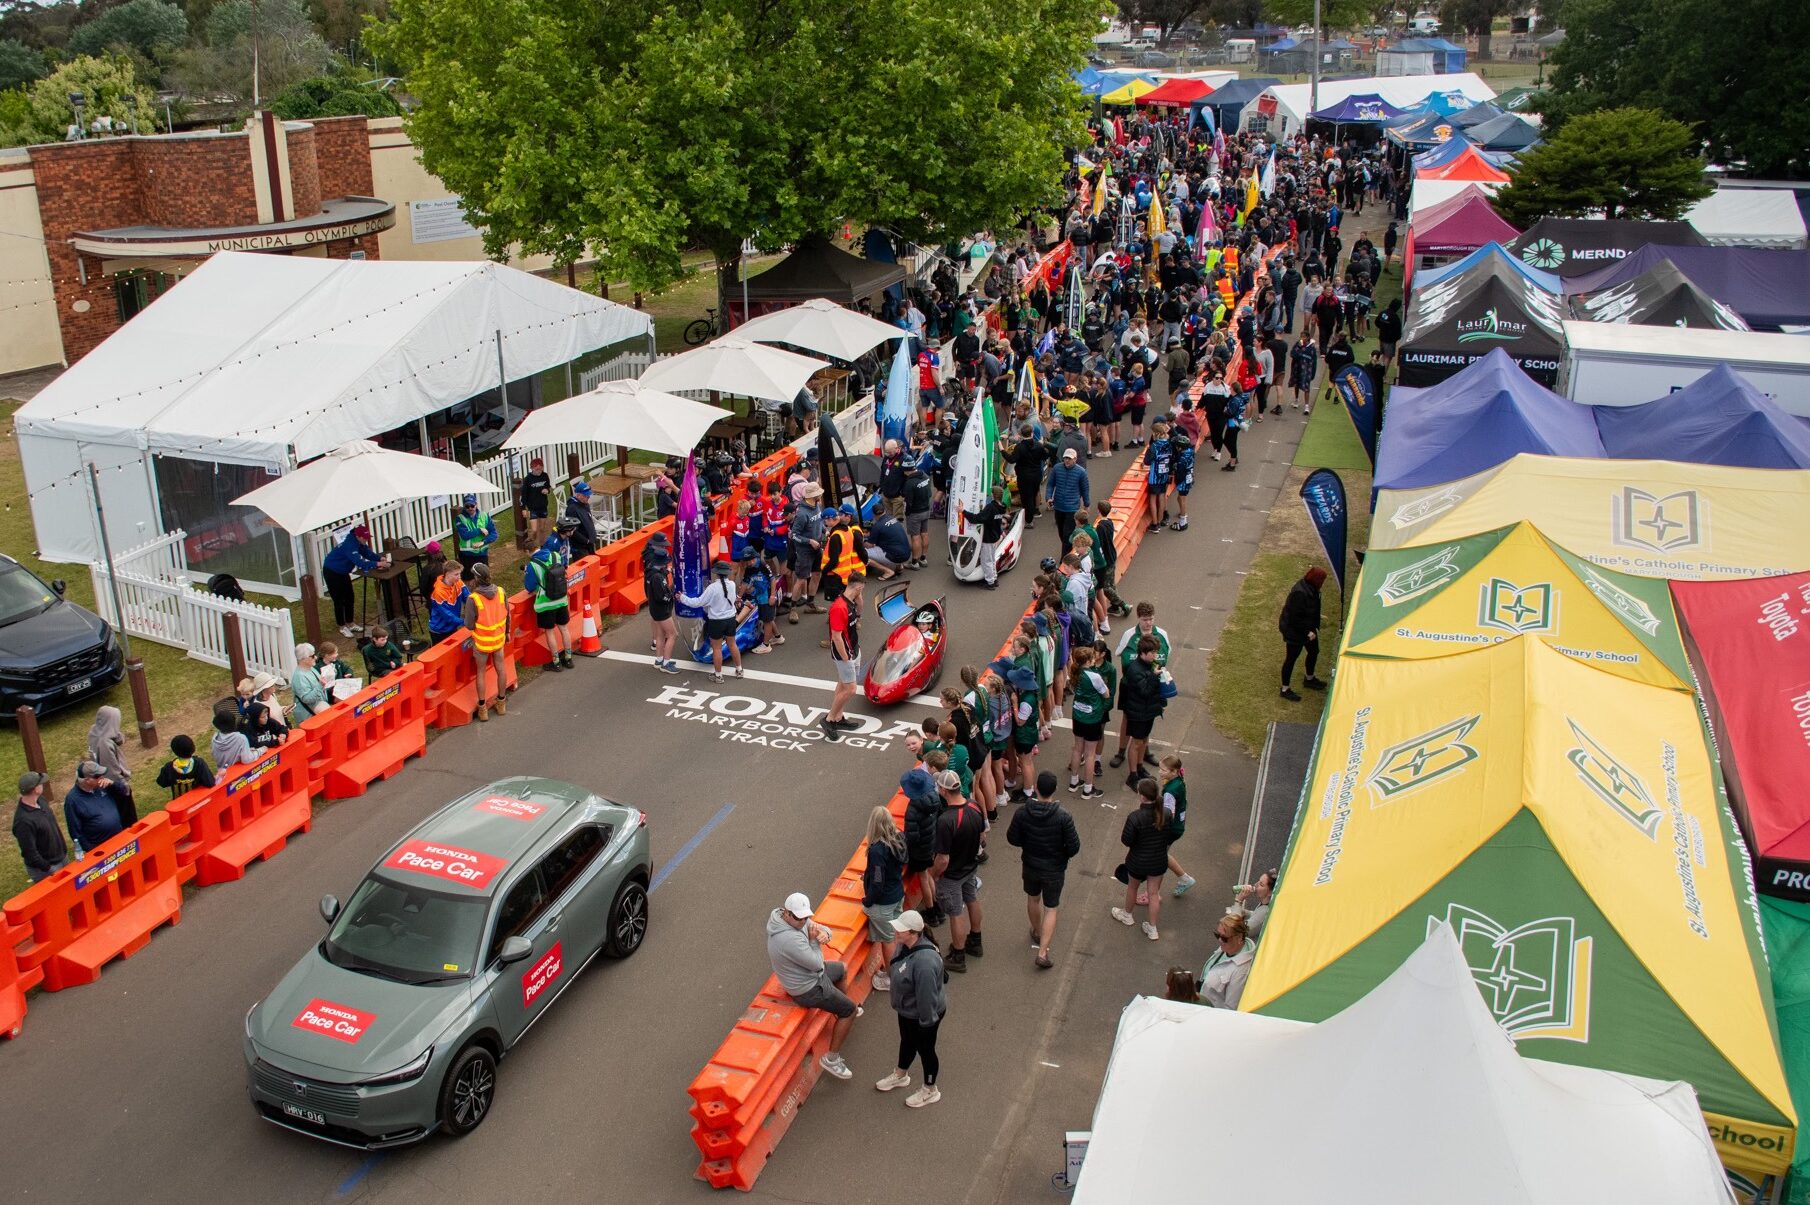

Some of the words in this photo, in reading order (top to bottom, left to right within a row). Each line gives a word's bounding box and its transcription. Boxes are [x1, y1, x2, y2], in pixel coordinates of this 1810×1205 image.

[208, 234, 292, 252] MUNICIPAL
[305, 224, 358, 243] OLYMPIC
[366, 218, 386, 233] POOL
[1406, 353, 1465, 364] LAURIMAR
[1313, 484, 1334, 524] WIZARDS
[1584, 556, 1630, 566] stine's
[1634, 558, 1694, 571] Catholic
[1700, 563, 1756, 576] Primary
[1757, 592, 1799, 641] Toyota
[1396, 628, 1412, 638] St.
[1416, 630, 1489, 643] Augustine's
[1550, 645, 1592, 659] rimary
[1596, 650, 1638, 663] School
[646, 685, 928, 740] HONDA
[1357, 706, 1371, 722] St.
[664, 708, 890, 752] MARYBOROUGH
[718, 730, 813, 753] TRACK
[1348, 720, 1368, 771] Augustine's
[1662, 741, 1674, 774] School
[1338, 770, 1358, 809] Catholic
[1667, 776, 1680, 808] Primary
[1326, 809, 1350, 848] Primary
[1672, 810, 1688, 848] Catholic
[398, 852, 445, 871] Pace
[446, 862, 484, 881] Car
[424, 846, 479, 863] HONDA
[1315, 848, 1341, 885] School
[1676, 848, 1700, 916] Augustine's
[525, 974, 546, 1000] Pace
[546, 957, 562, 978] Car
[530, 954, 555, 982] HONDA
[300, 1010, 334, 1028] Pace
[334, 1020, 362, 1037] Car
[319, 1006, 358, 1022] HONDA
[1708, 1124, 1784, 1152] chool
